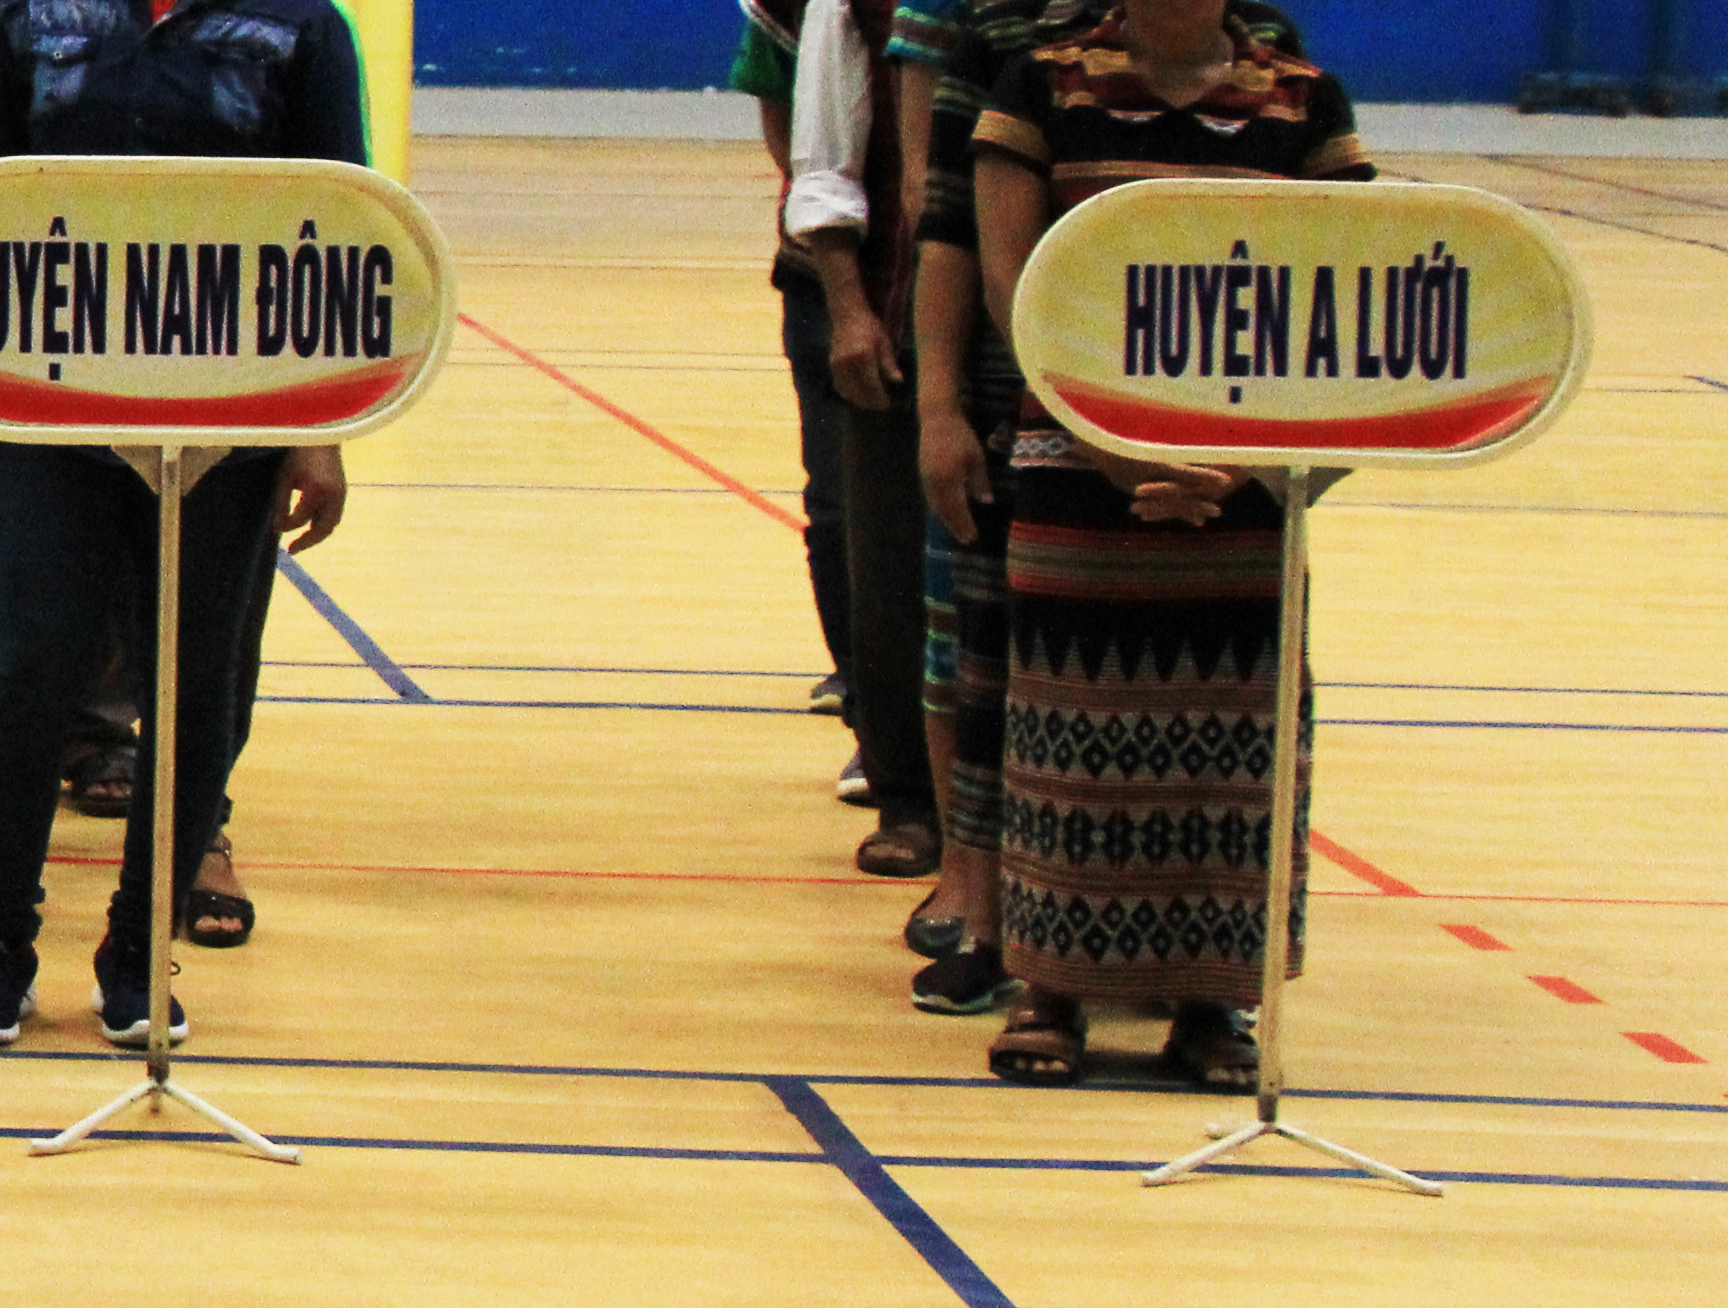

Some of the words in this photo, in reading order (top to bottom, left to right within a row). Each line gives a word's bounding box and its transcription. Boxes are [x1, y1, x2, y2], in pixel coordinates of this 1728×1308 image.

[126, 244, 239, 355] NAM
[257, 221, 392, 358] ĐÔNG
[1126, 241, 1290, 403] HUYỆN
[1306, 266, 1338, 377] A
[1357, 242, 1468, 380] LƯỚI
